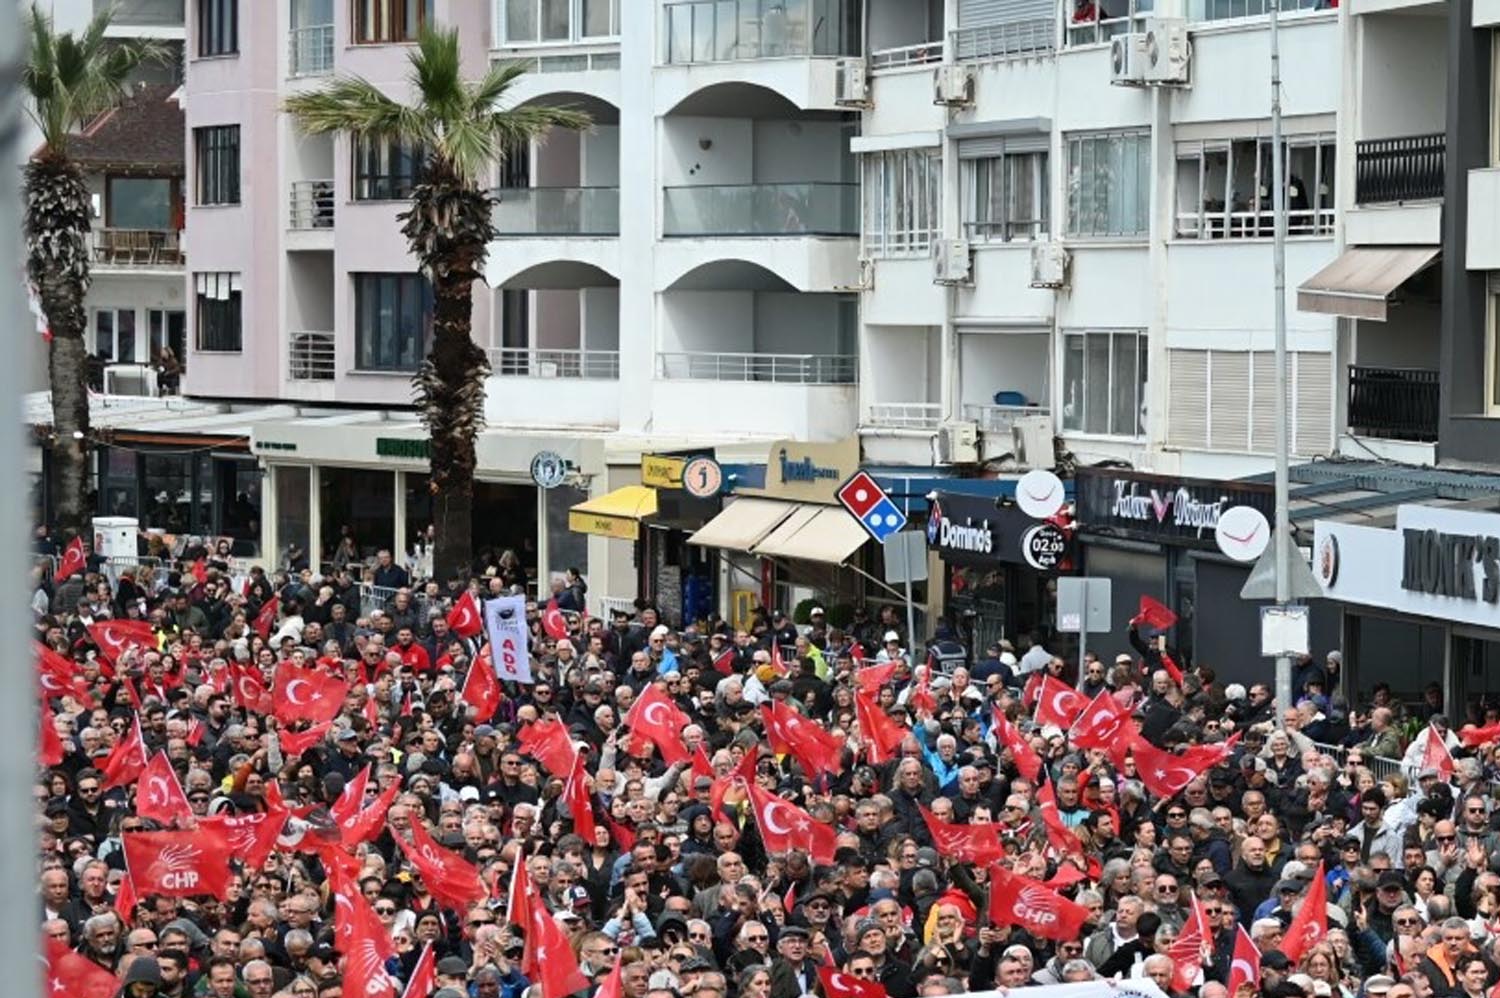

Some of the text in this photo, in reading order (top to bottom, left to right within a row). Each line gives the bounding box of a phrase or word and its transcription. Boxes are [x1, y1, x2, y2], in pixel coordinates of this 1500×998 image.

[940, 516, 992, 554] Domino's
[162, 871, 199, 889] CHP
[1012, 903, 1057, 924] CHP
